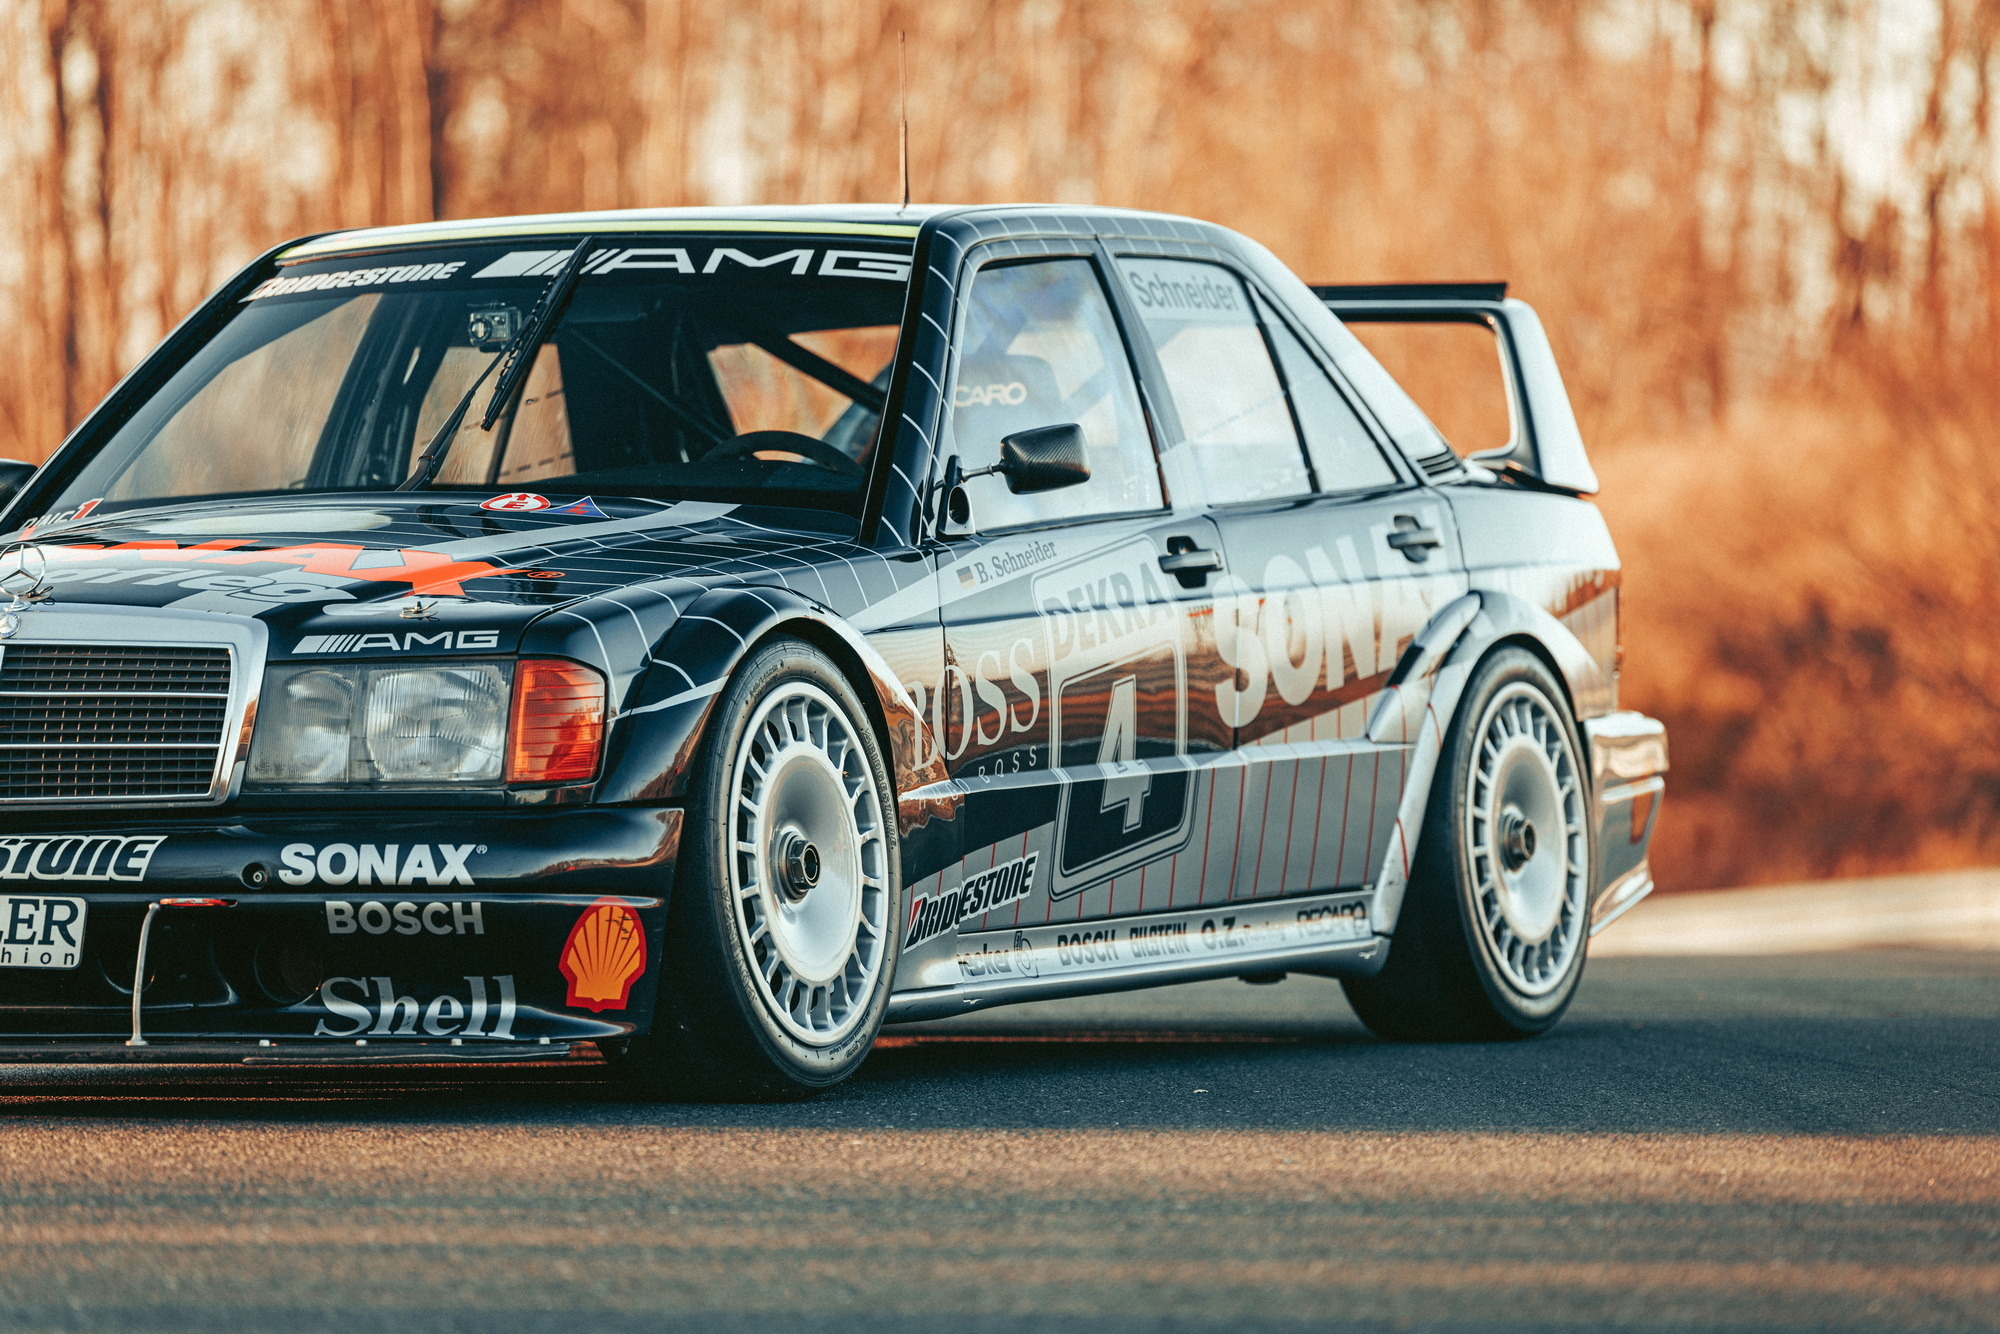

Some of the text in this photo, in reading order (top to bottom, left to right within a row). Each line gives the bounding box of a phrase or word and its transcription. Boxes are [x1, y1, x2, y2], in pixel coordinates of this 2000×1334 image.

[238, 261, 467, 303] BRIDGESTONE
[591, 247, 912, 282] AMG
[1129, 270, 1240, 312] Schneider
[973, 541, 1058, 584] B. Schneider
[1042, 562, 1175, 663] DEKRA
[350, 630, 500, 653] AMG
[902, 637, 1041, 772] BOSS
[978, 745, 1038, 784] BOSS
[1098, 674, 1152, 834] 4
[0, 898, 79, 948] ER
[325, 900, 485, 935] BOSCH
[903, 851, 1040, 954] BRIDESTONE
[956, 942, 1013, 977] ecker
[1056, 928, 1121, 967] BOSCH
[313, 975, 517, 1040] Shell
